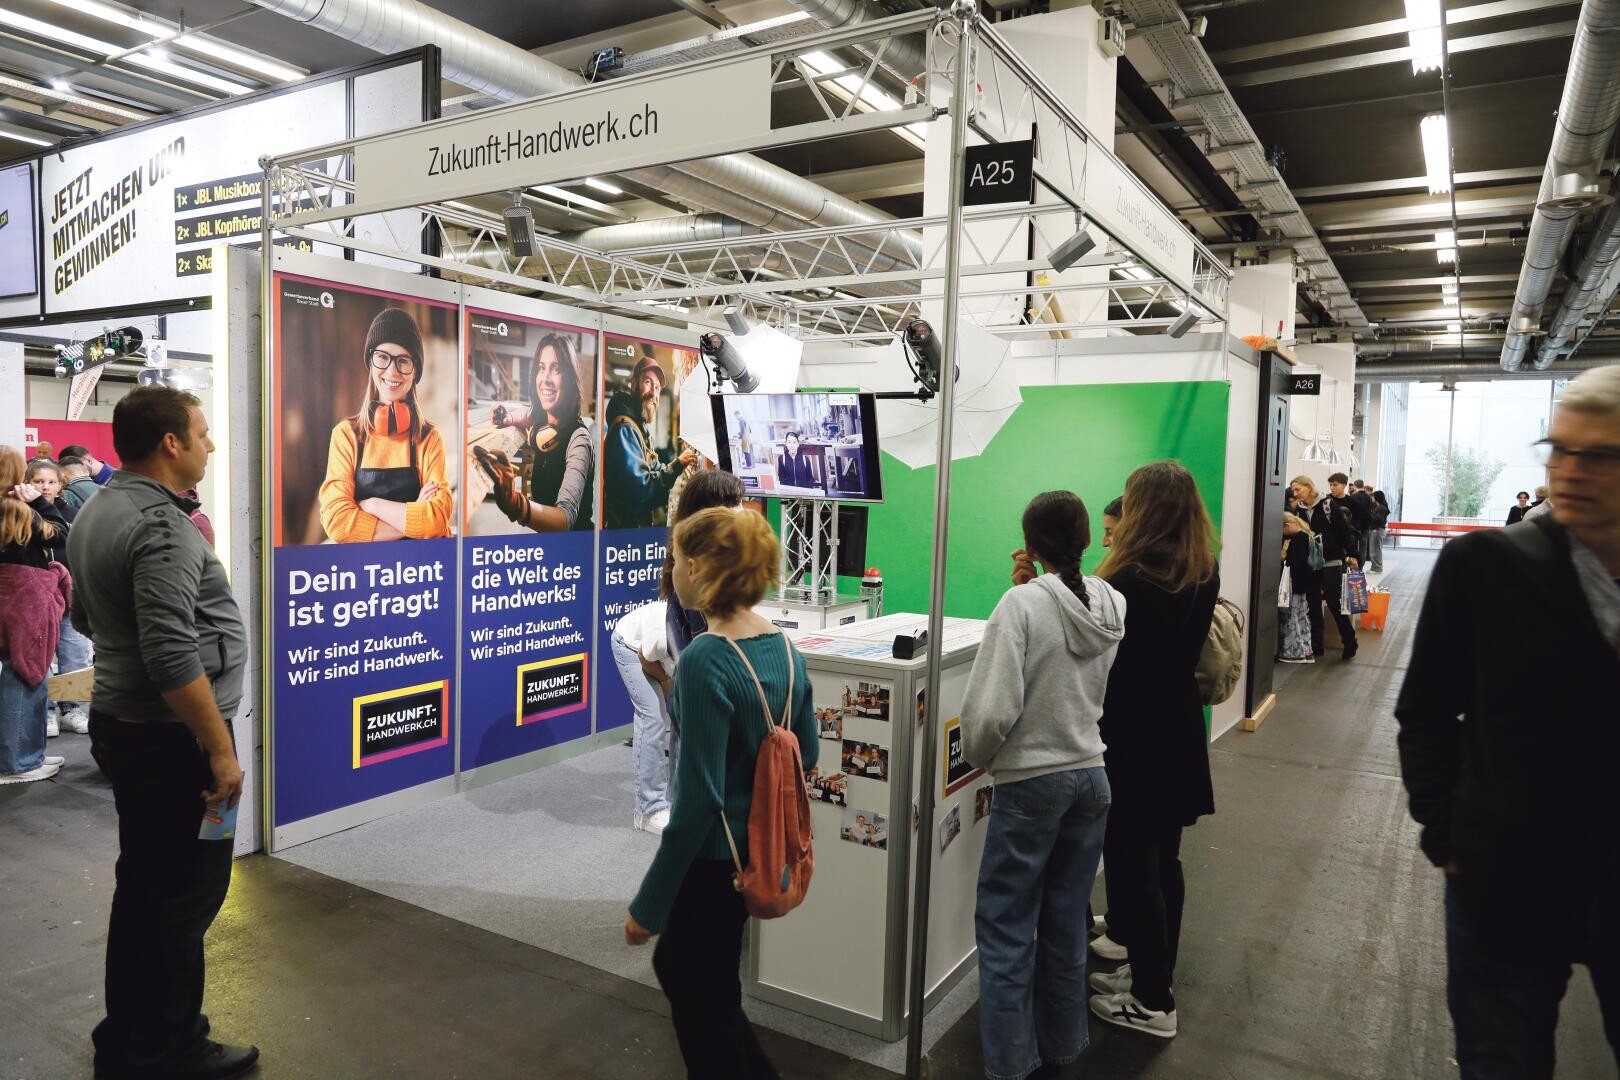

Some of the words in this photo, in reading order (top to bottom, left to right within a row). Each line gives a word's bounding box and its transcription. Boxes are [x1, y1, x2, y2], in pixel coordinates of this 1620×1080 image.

[428, 103, 658, 176] Zukunft-Handwerk.ch
[969, 160, 1015, 187] A25
[52, 167, 92, 224] JETZT
[194, 186, 211, 205] JBL
[214, 182, 261, 202] Musikbox
[53, 165, 142, 261] MITMACHEN
[195, 221, 213, 239] JBL
[215, 216, 261, 236] Kopfhörer
[54, 209, 136, 295] GEWINNEN!
[1294, 379, 1314, 389] A26
[472, 545, 544, 566] Erobere
[606, 543, 641, 564] Dein
[289, 565, 356, 595] Dein
[364, 561, 443, 588] Talent
[471, 569, 502, 590] die
[506, 565, 548, 586] Welt
[552, 563, 581, 581] des
[605, 566, 624, 585] ist
[289, 600, 325, 627] ist
[333, 588, 439, 627] gefragt!
[471, 584, 576, 614] Handwerks!
[604, 602, 623, 616] Wir
[470, 627, 494, 643] Wir
[496, 623, 523, 639] sind
[525, 616, 573, 635] Zukunft.
[288, 646, 320, 665] Wir
[324, 640, 359, 660] sind
[363, 631, 428, 653] Zukunft.
[470, 645, 494, 661] Wir
[496, 640, 523, 656] sind
[525, 631, 584, 652] Handwerk.
[288, 667, 320, 686] Wir
[324, 660, 359, 680] sind
[363, 647, 444, 673] Handwerk.
[526, 685, 579, 704] HANDWERK.CH
[527, 673, 579, 694] ZUKUNFT-
[366, 718, 437, 742] HANDWERK.CH
[367, 704, 437, 730] ZUKUNFT-
